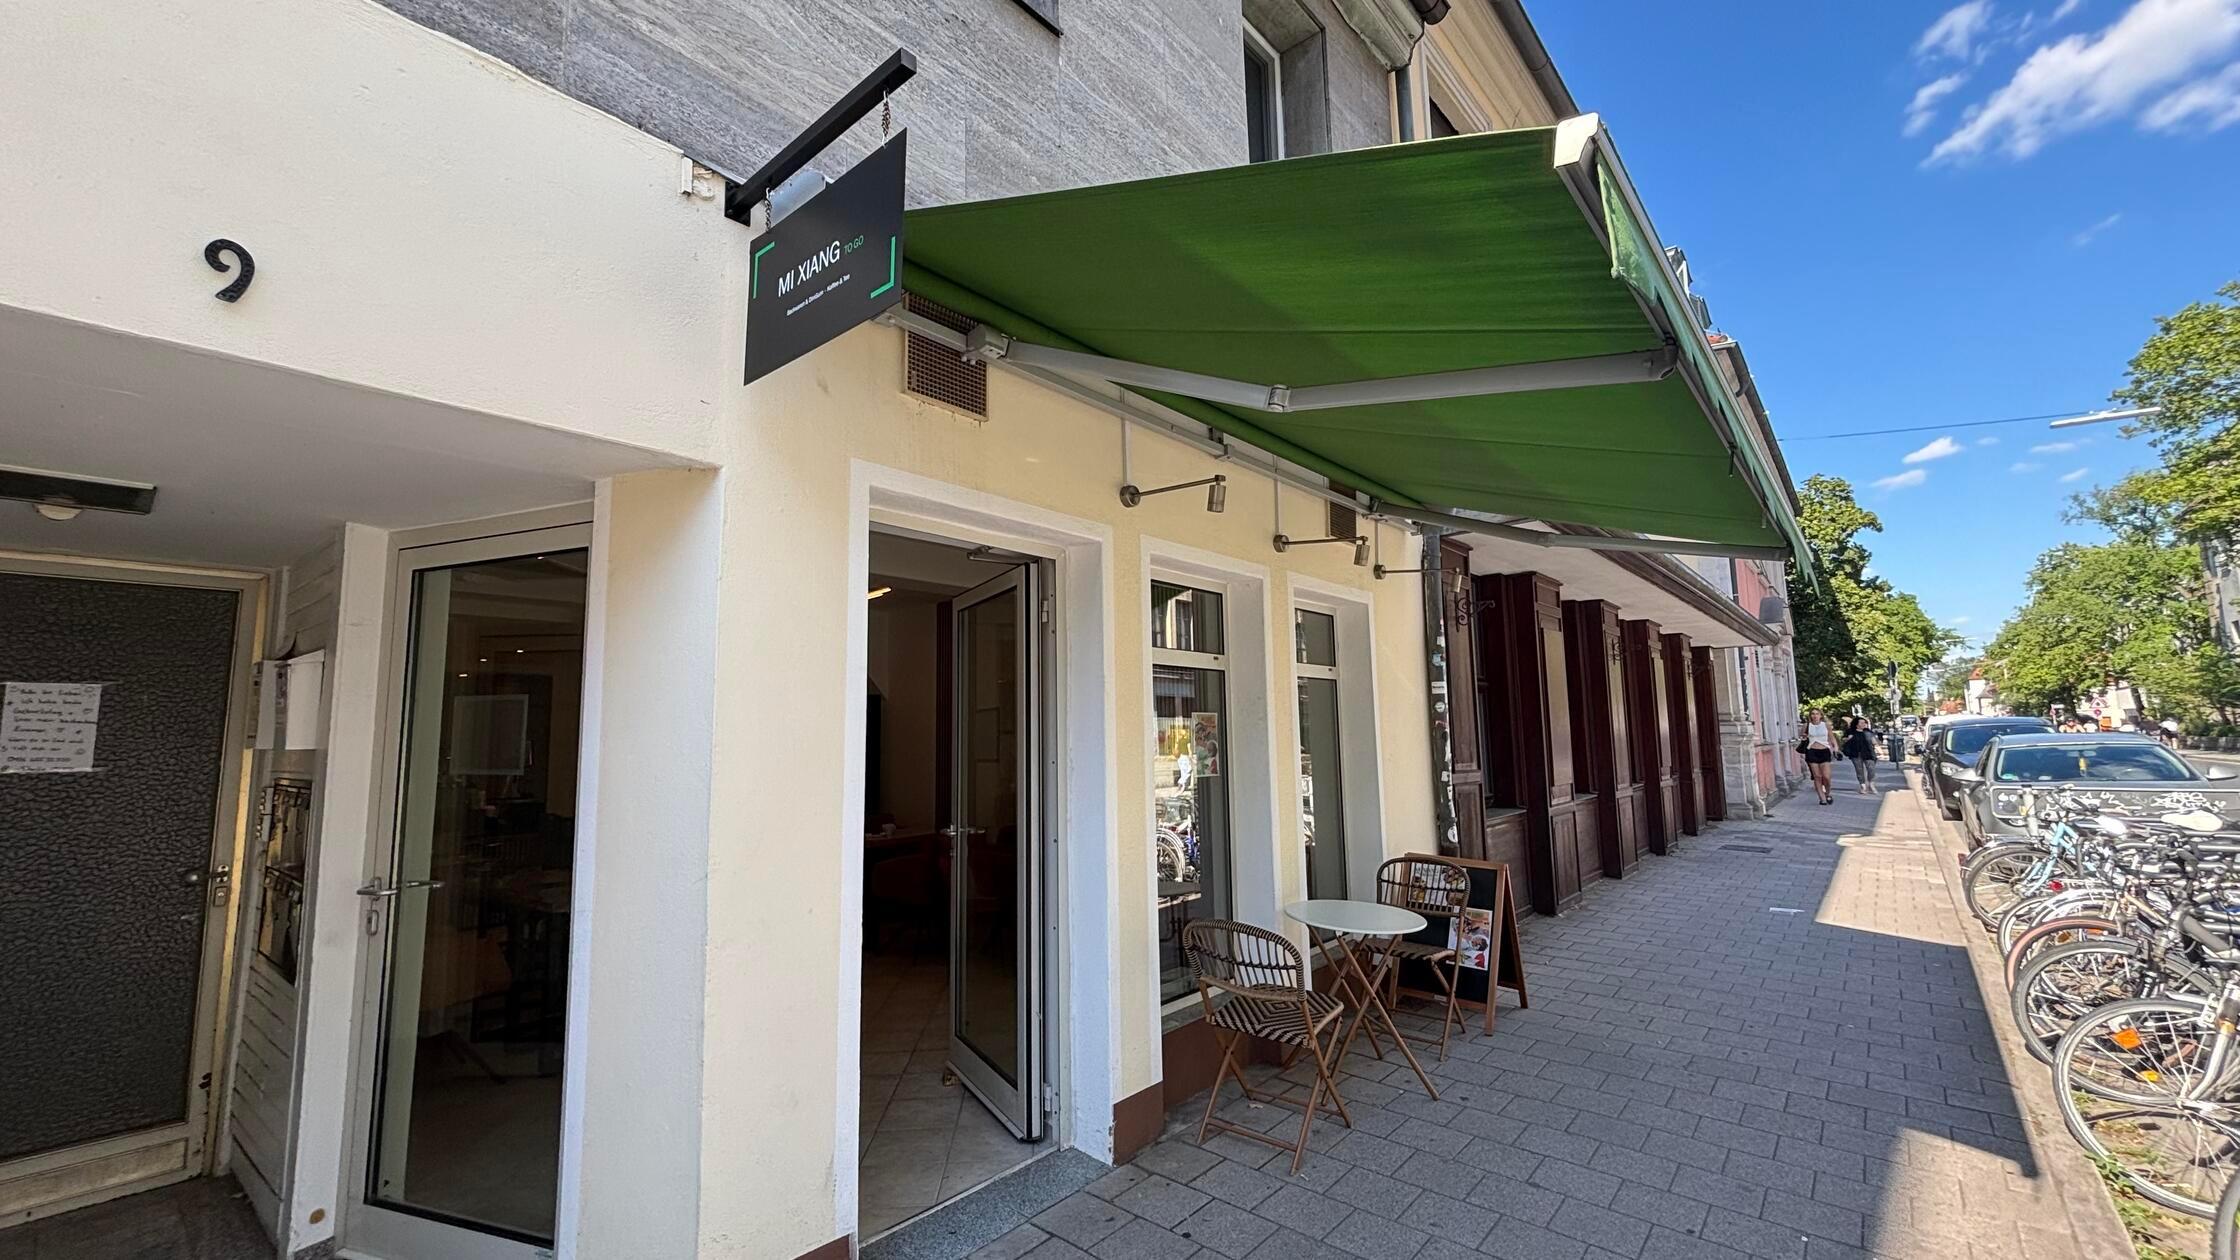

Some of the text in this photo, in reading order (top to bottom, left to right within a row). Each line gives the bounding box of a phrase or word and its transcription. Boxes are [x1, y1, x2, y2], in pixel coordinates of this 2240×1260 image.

[204, 238, 255, 303] 9
[778, 234, 864, 298] MI XIANG TO GO
